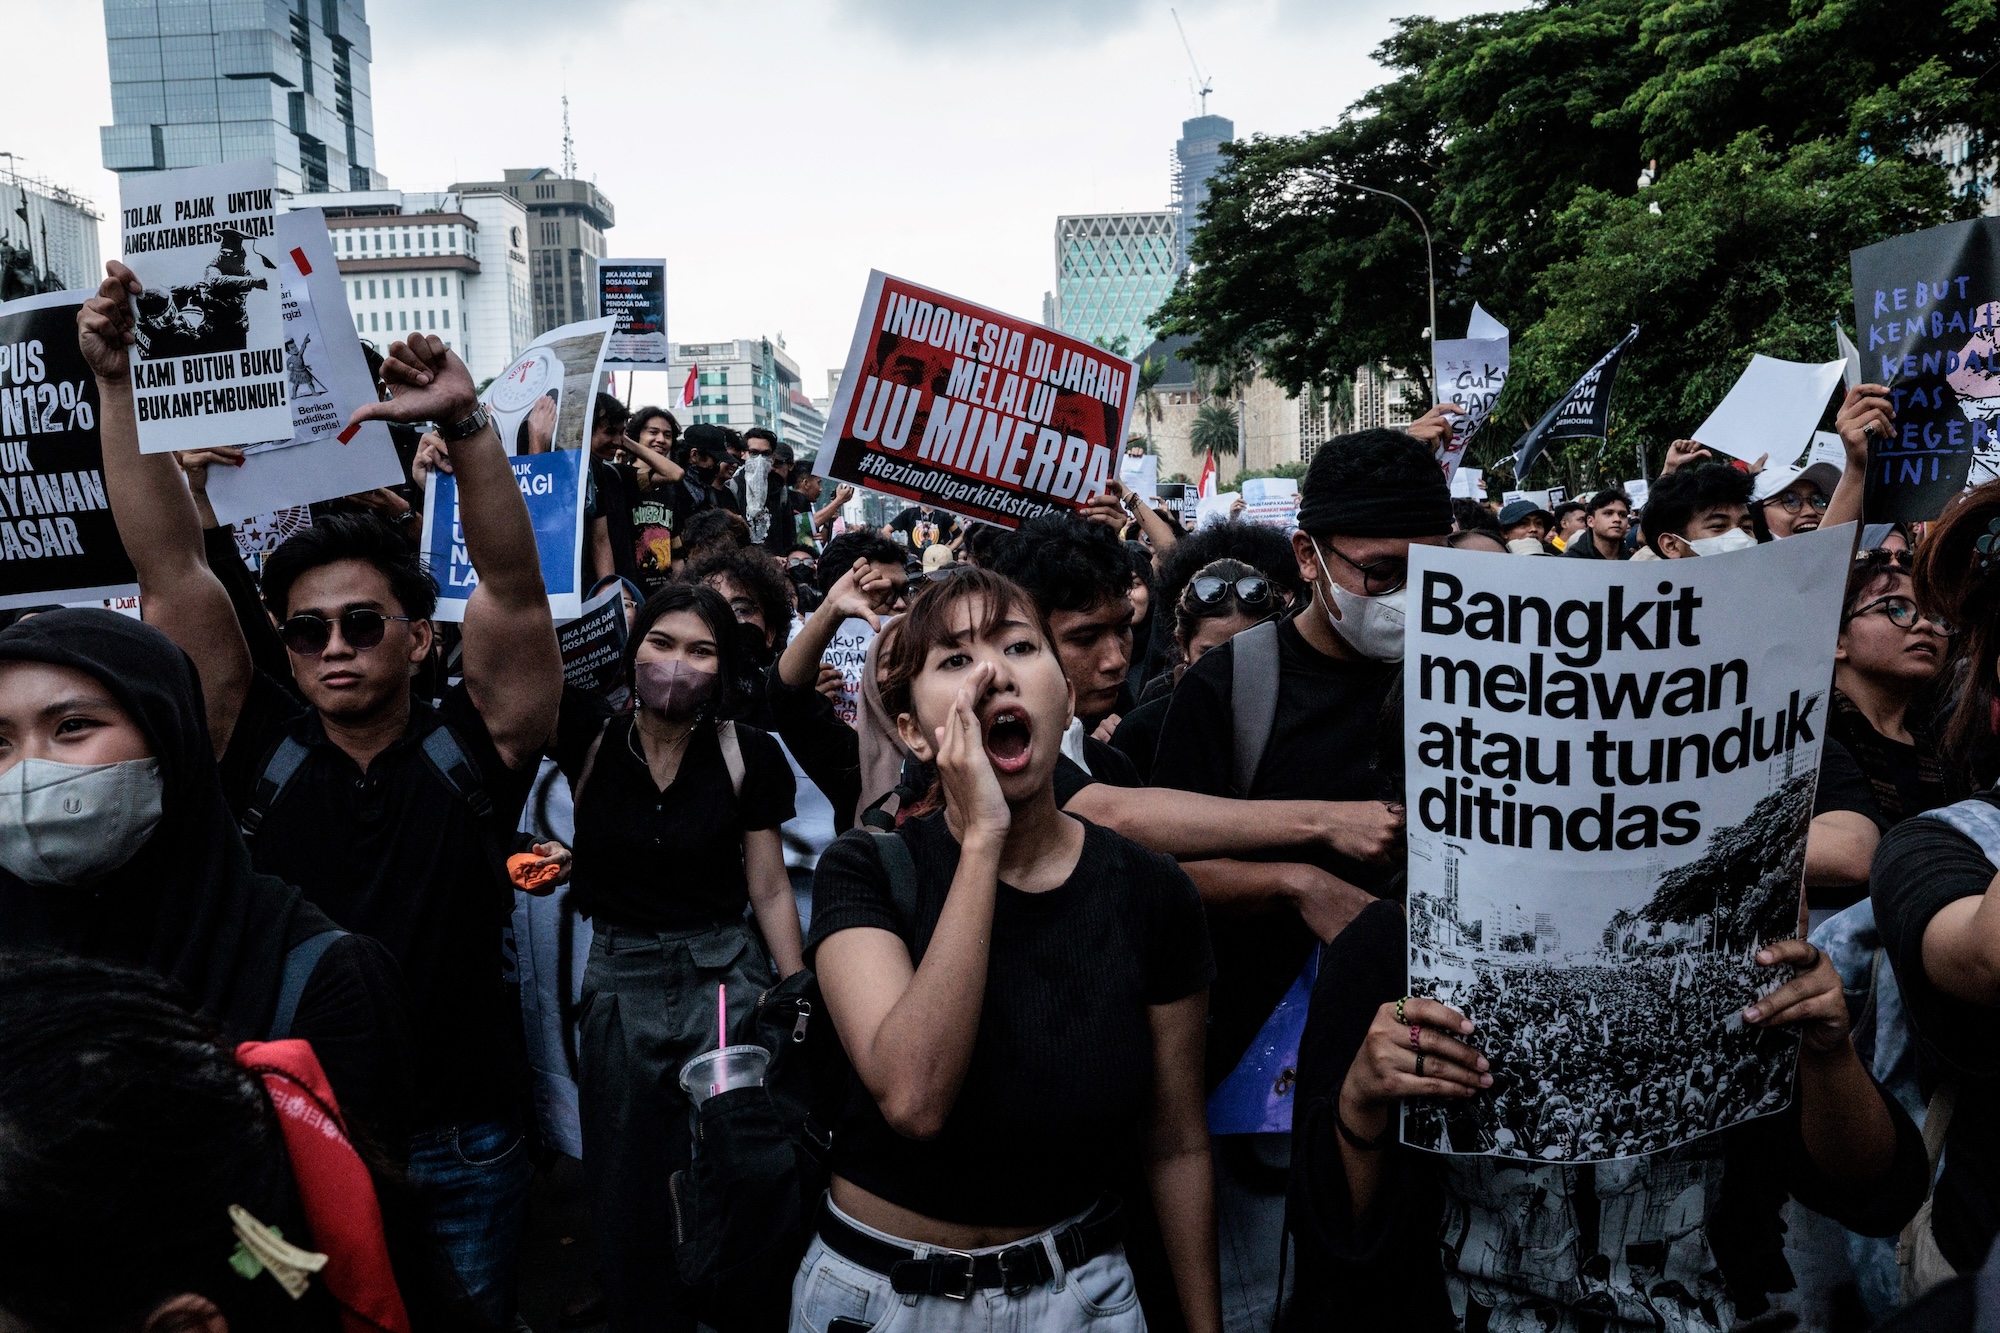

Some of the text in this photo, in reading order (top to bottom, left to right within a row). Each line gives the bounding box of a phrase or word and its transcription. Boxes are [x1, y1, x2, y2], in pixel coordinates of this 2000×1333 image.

[124, 188, 272, 229] TOLAK PAJAK UNTUK
[1874, 276, 1970, 319] REBUT
[1870, 303, 1993, 351] KEMBALI
[134, 348, 283, 389] KAMI BUTUH BUKU
[882, 291, 1125, 408] INDONESIA DIJARAH
[298, 402, 335, 415] Berikan
[945, 357, 1057, 425] MELALUI
[292, 412, 338, 427] endidikan
[311, 420, 341, 435] gratis!
[852, 375, 1112, 504] UU MINERBA
[1884, 457, 1950, 485] INI.
[0, 516, 84, 560] ASAR
[116, 596, 137, 609] Duit
[1420, 569, 1703, 668] Bangkit
[562, 608, 616, 642] JIKA AKAR DARI
[562, 636, 585, 652] DOSA
[586, 620, 615, 642] ADALAH
[588, 644, 611, 660] MAHA
[601, 650, 620, 665] DARI
[822, 651, 867, 667] ADAN
[1420, 651, 1749, 720] melawan
[1418, 690, 1821, 787] atau tunduk
[1418, 776, 1701, 852] ditindas
